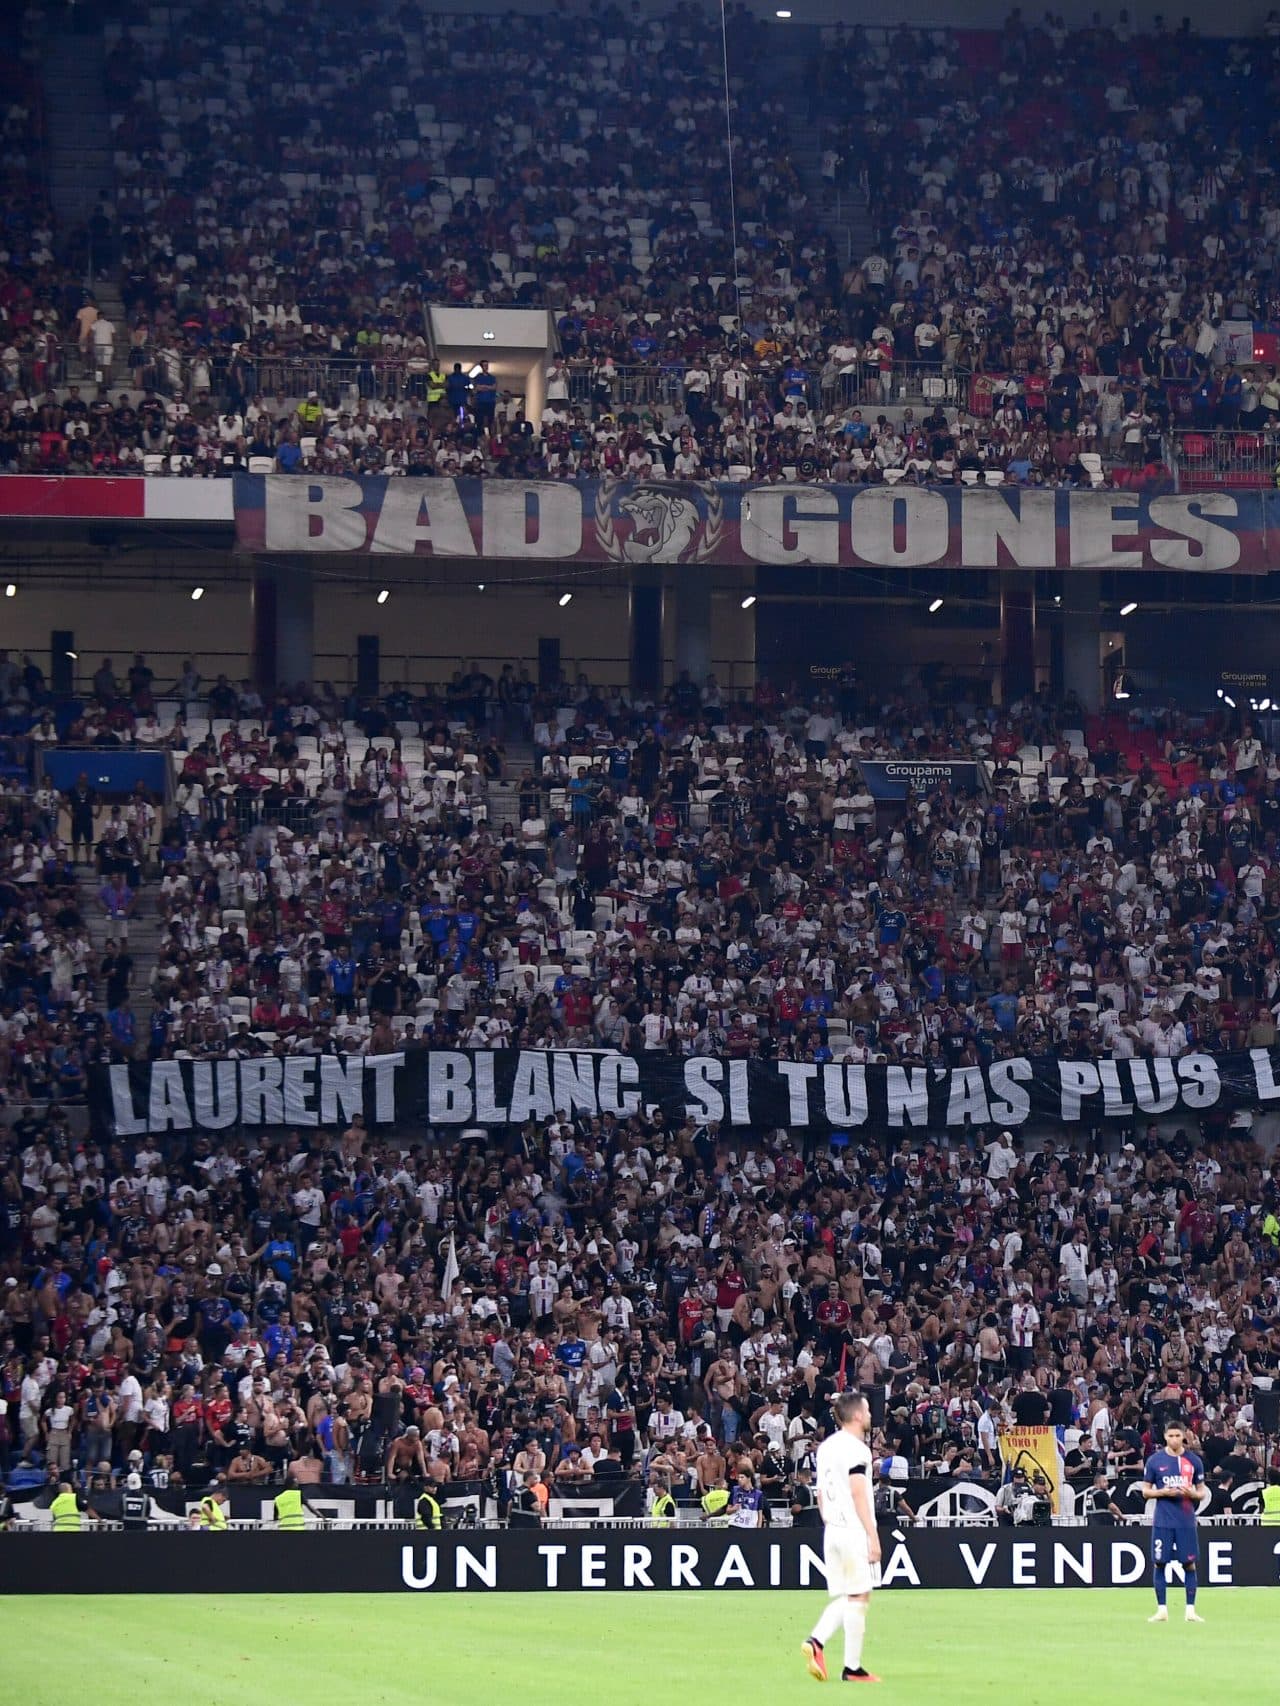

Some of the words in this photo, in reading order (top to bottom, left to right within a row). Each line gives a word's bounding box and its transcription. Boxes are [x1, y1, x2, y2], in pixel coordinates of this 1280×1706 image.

[265, 474, 583, 558] BAD
[740, 485, 1240, 571] GONES
[1221, 672, 1267, 684] Groupama
[886, 764, 952, 778] Groupama
[109, 1052, 405, 1135] LAURENT
[684, 1056, 751, 1126] SI
[778, 1061, 868, 1127] TU
[886, 1057, 1034, 1127] N'AS
[1059, 1054, 1221, 1121] PLUS
[402, 1545, 497, 1589] UN
[881, 1529, 921, 1585] À
[1154, 1540, 1163, 1552] 2
